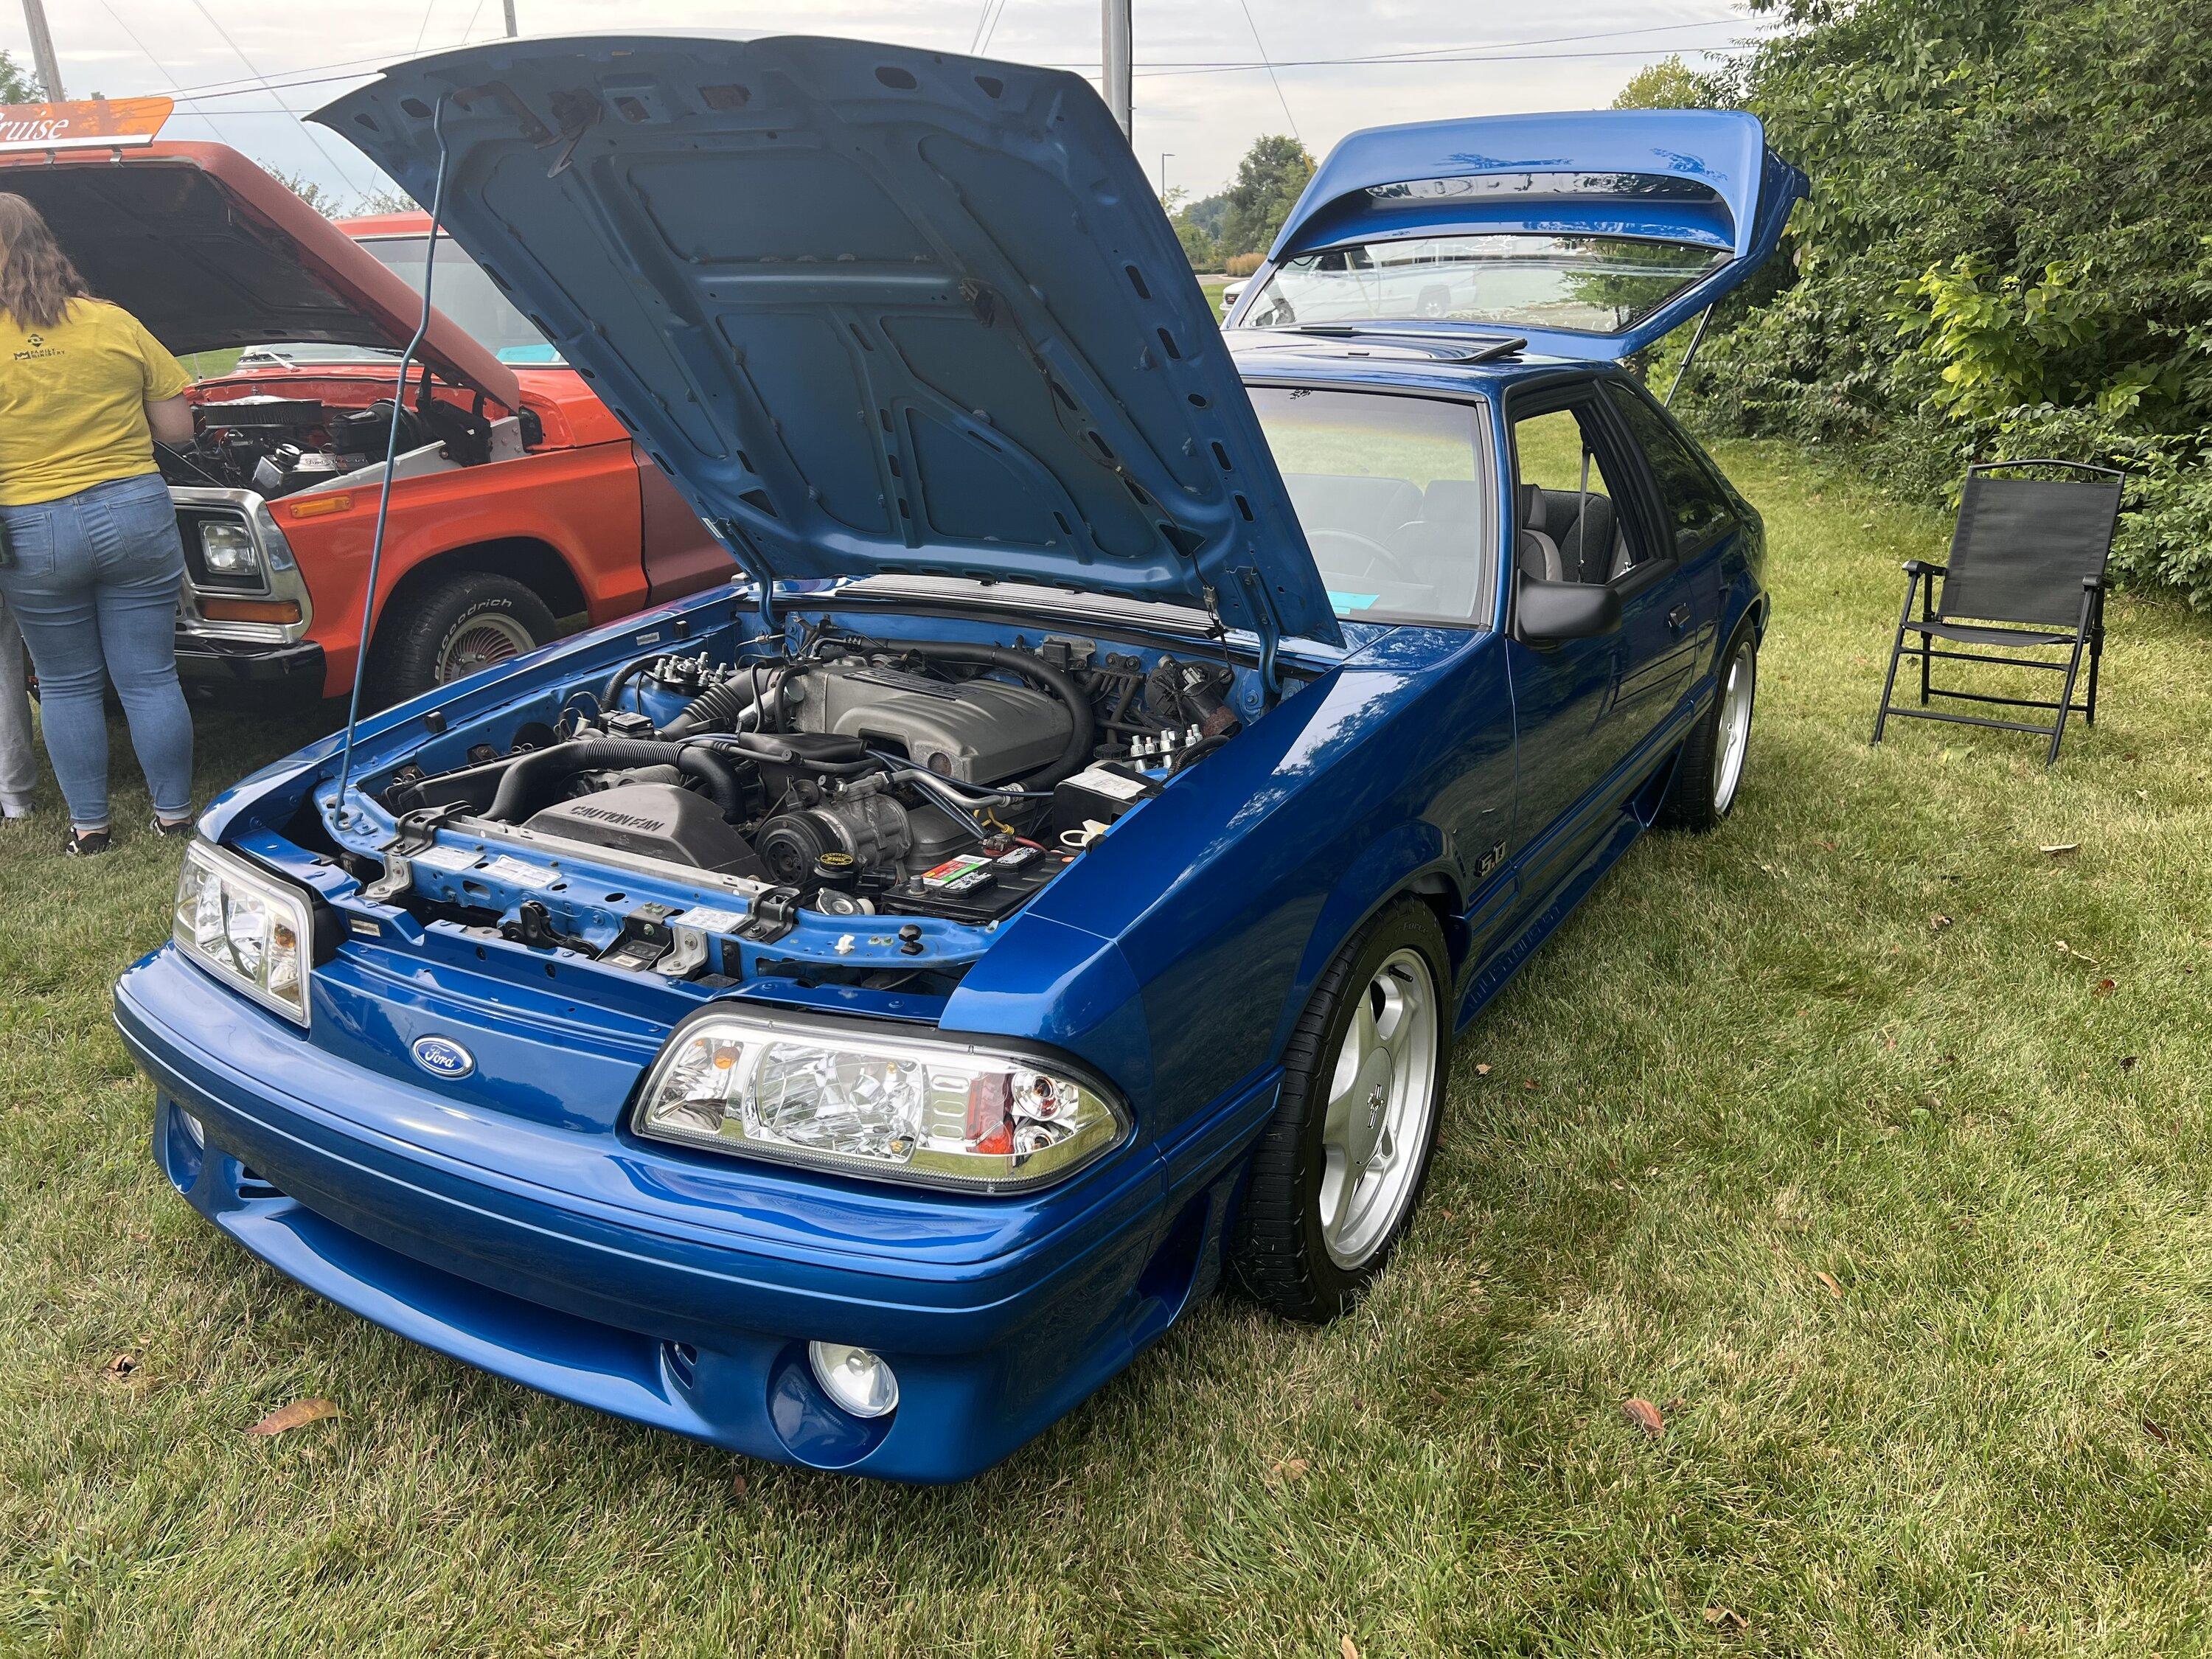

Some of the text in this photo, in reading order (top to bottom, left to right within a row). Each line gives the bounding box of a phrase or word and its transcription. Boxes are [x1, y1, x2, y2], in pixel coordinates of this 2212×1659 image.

[0, 111, 69, 141] ruise
[569, 805, 664, 832] CAUTION FAN
[425, 1044, 456, 1068] Ford
